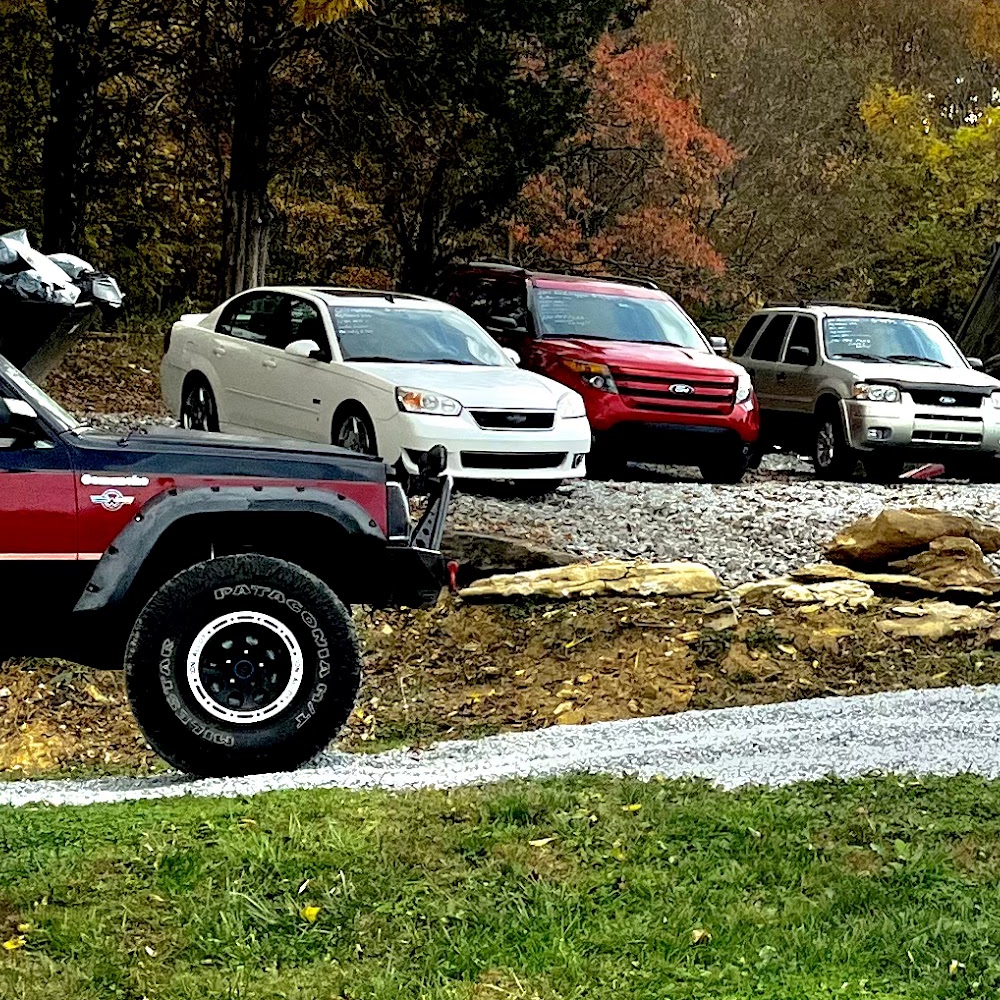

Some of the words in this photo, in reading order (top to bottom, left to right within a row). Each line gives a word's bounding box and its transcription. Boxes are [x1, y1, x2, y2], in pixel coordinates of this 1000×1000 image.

[159, 637, 235, 747] MILESTAR
[213, 584, 331, 679] PATAGONIA
[295, 683, 328, 729] M/T
